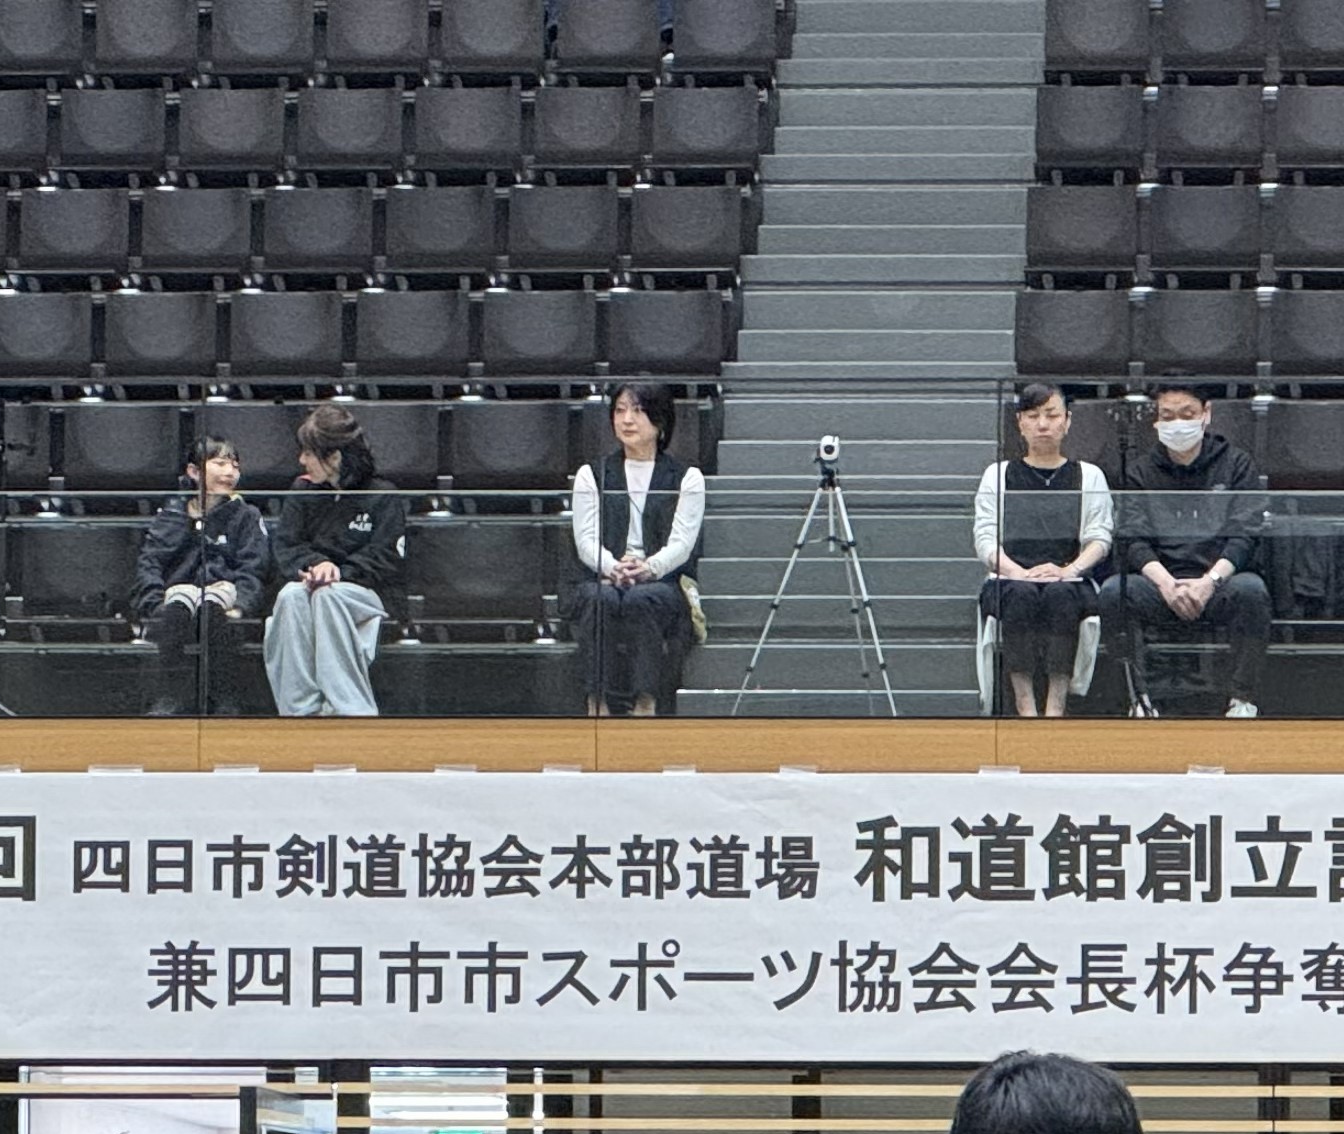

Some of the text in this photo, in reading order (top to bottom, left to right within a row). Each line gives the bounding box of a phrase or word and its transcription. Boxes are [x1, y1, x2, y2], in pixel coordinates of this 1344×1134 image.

[72, 833, 821, 901] 四日市剣道協会本部道場
